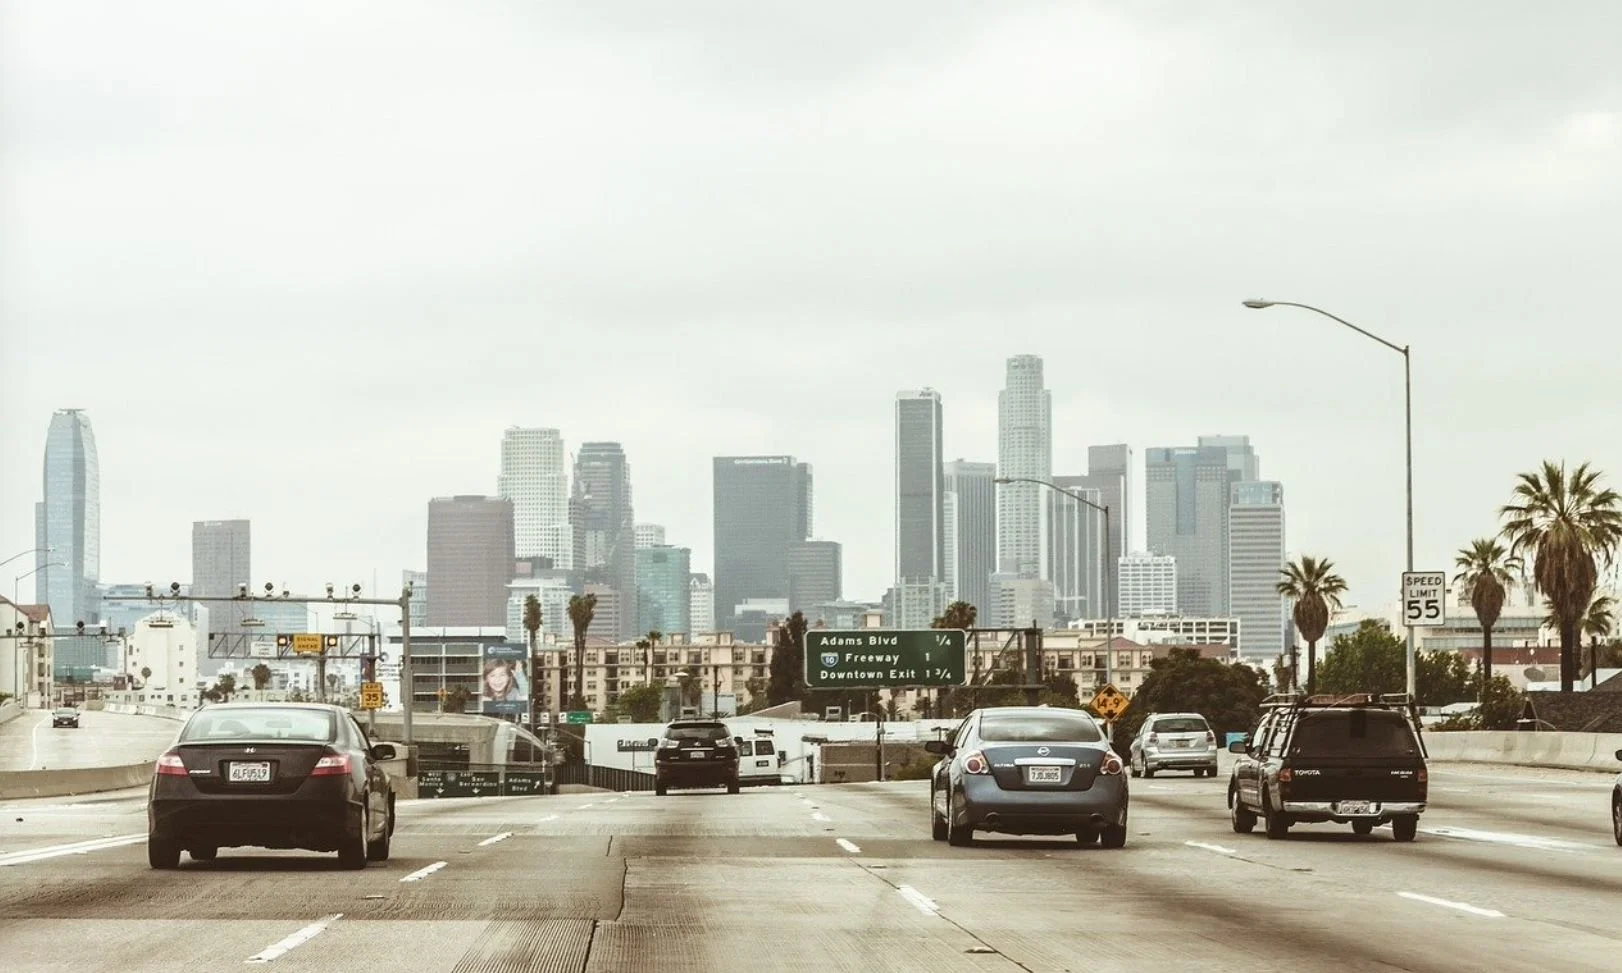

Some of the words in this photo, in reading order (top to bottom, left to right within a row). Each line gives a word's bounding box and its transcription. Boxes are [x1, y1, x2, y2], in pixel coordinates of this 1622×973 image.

[1406, 576, 1442, 586] SPEED
[1409, 589, 1438, 598] LIMIT
[1407, 599, 1440, 620] 55
[820, 636, 863, 646] Adams
[869, 636, 898, 646] Blvd
[935, 634, 951, 646] 1/4
[845, 653, 900, 666] Freeway
[925, 652, 930, 662] 1
[820, 670, 884, 680] Downtown
[889, 669, 916, 679] Exit
[926, 669, 931, 679] 1
[365, 692, 379, 702] 35
[1294, 768, 1321, 776] TOYOTA
